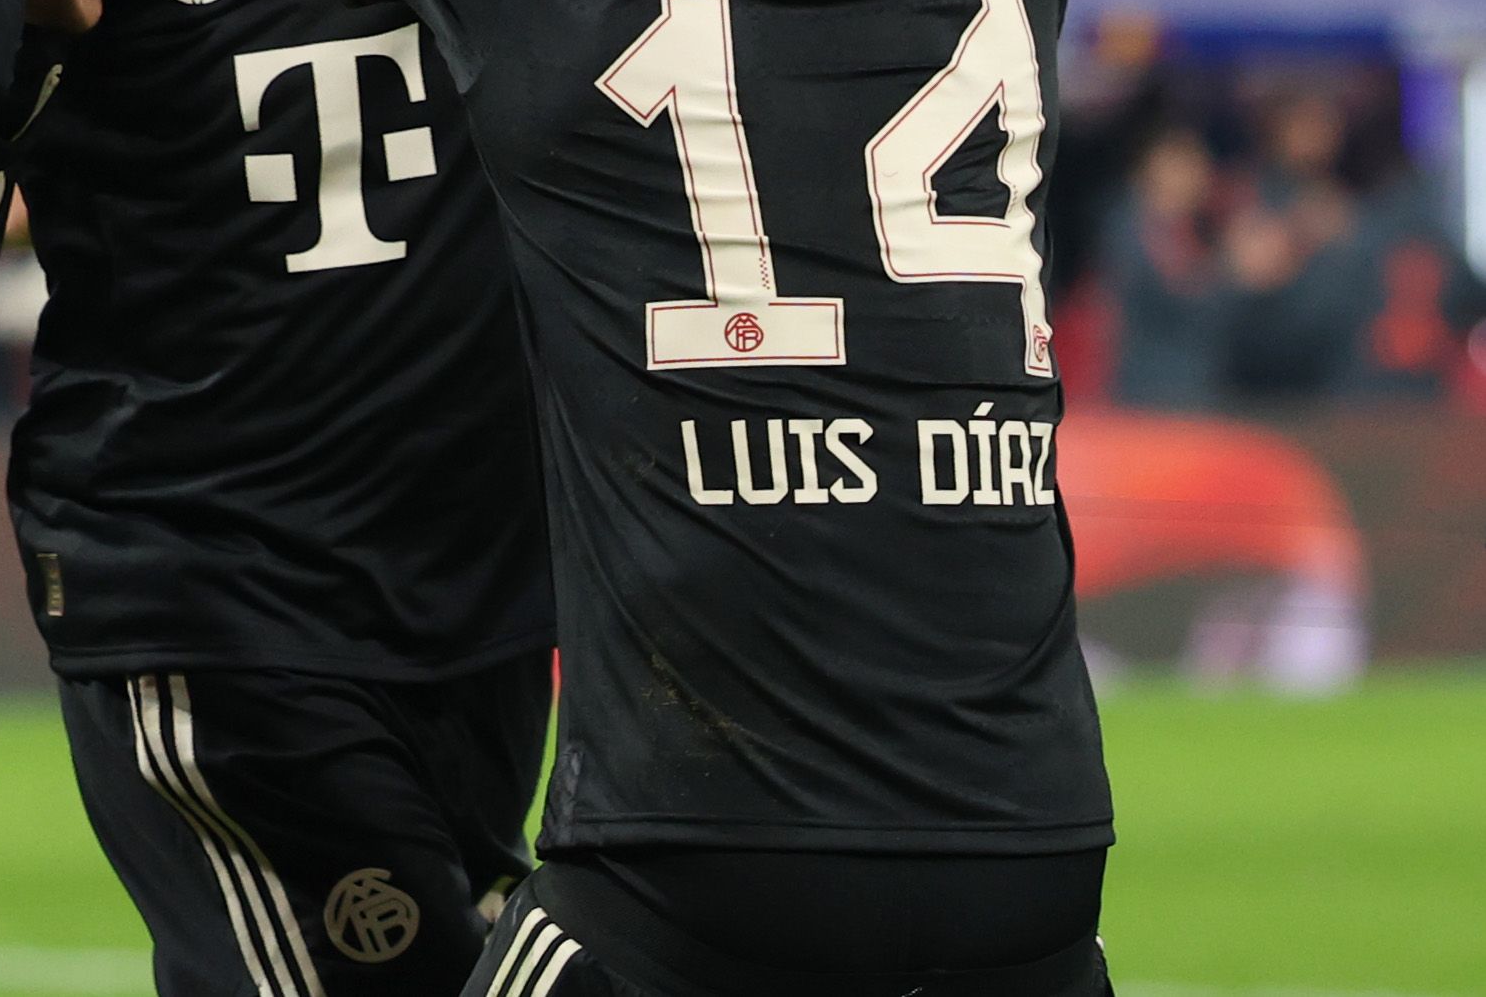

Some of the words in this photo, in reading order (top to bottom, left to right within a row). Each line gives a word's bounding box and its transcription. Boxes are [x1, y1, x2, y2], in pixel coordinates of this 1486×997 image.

[233, 22, 438, 273] T
[680, 418, 879, 506] LUIS
[917, 401, 1056, 506] DÍAZ
